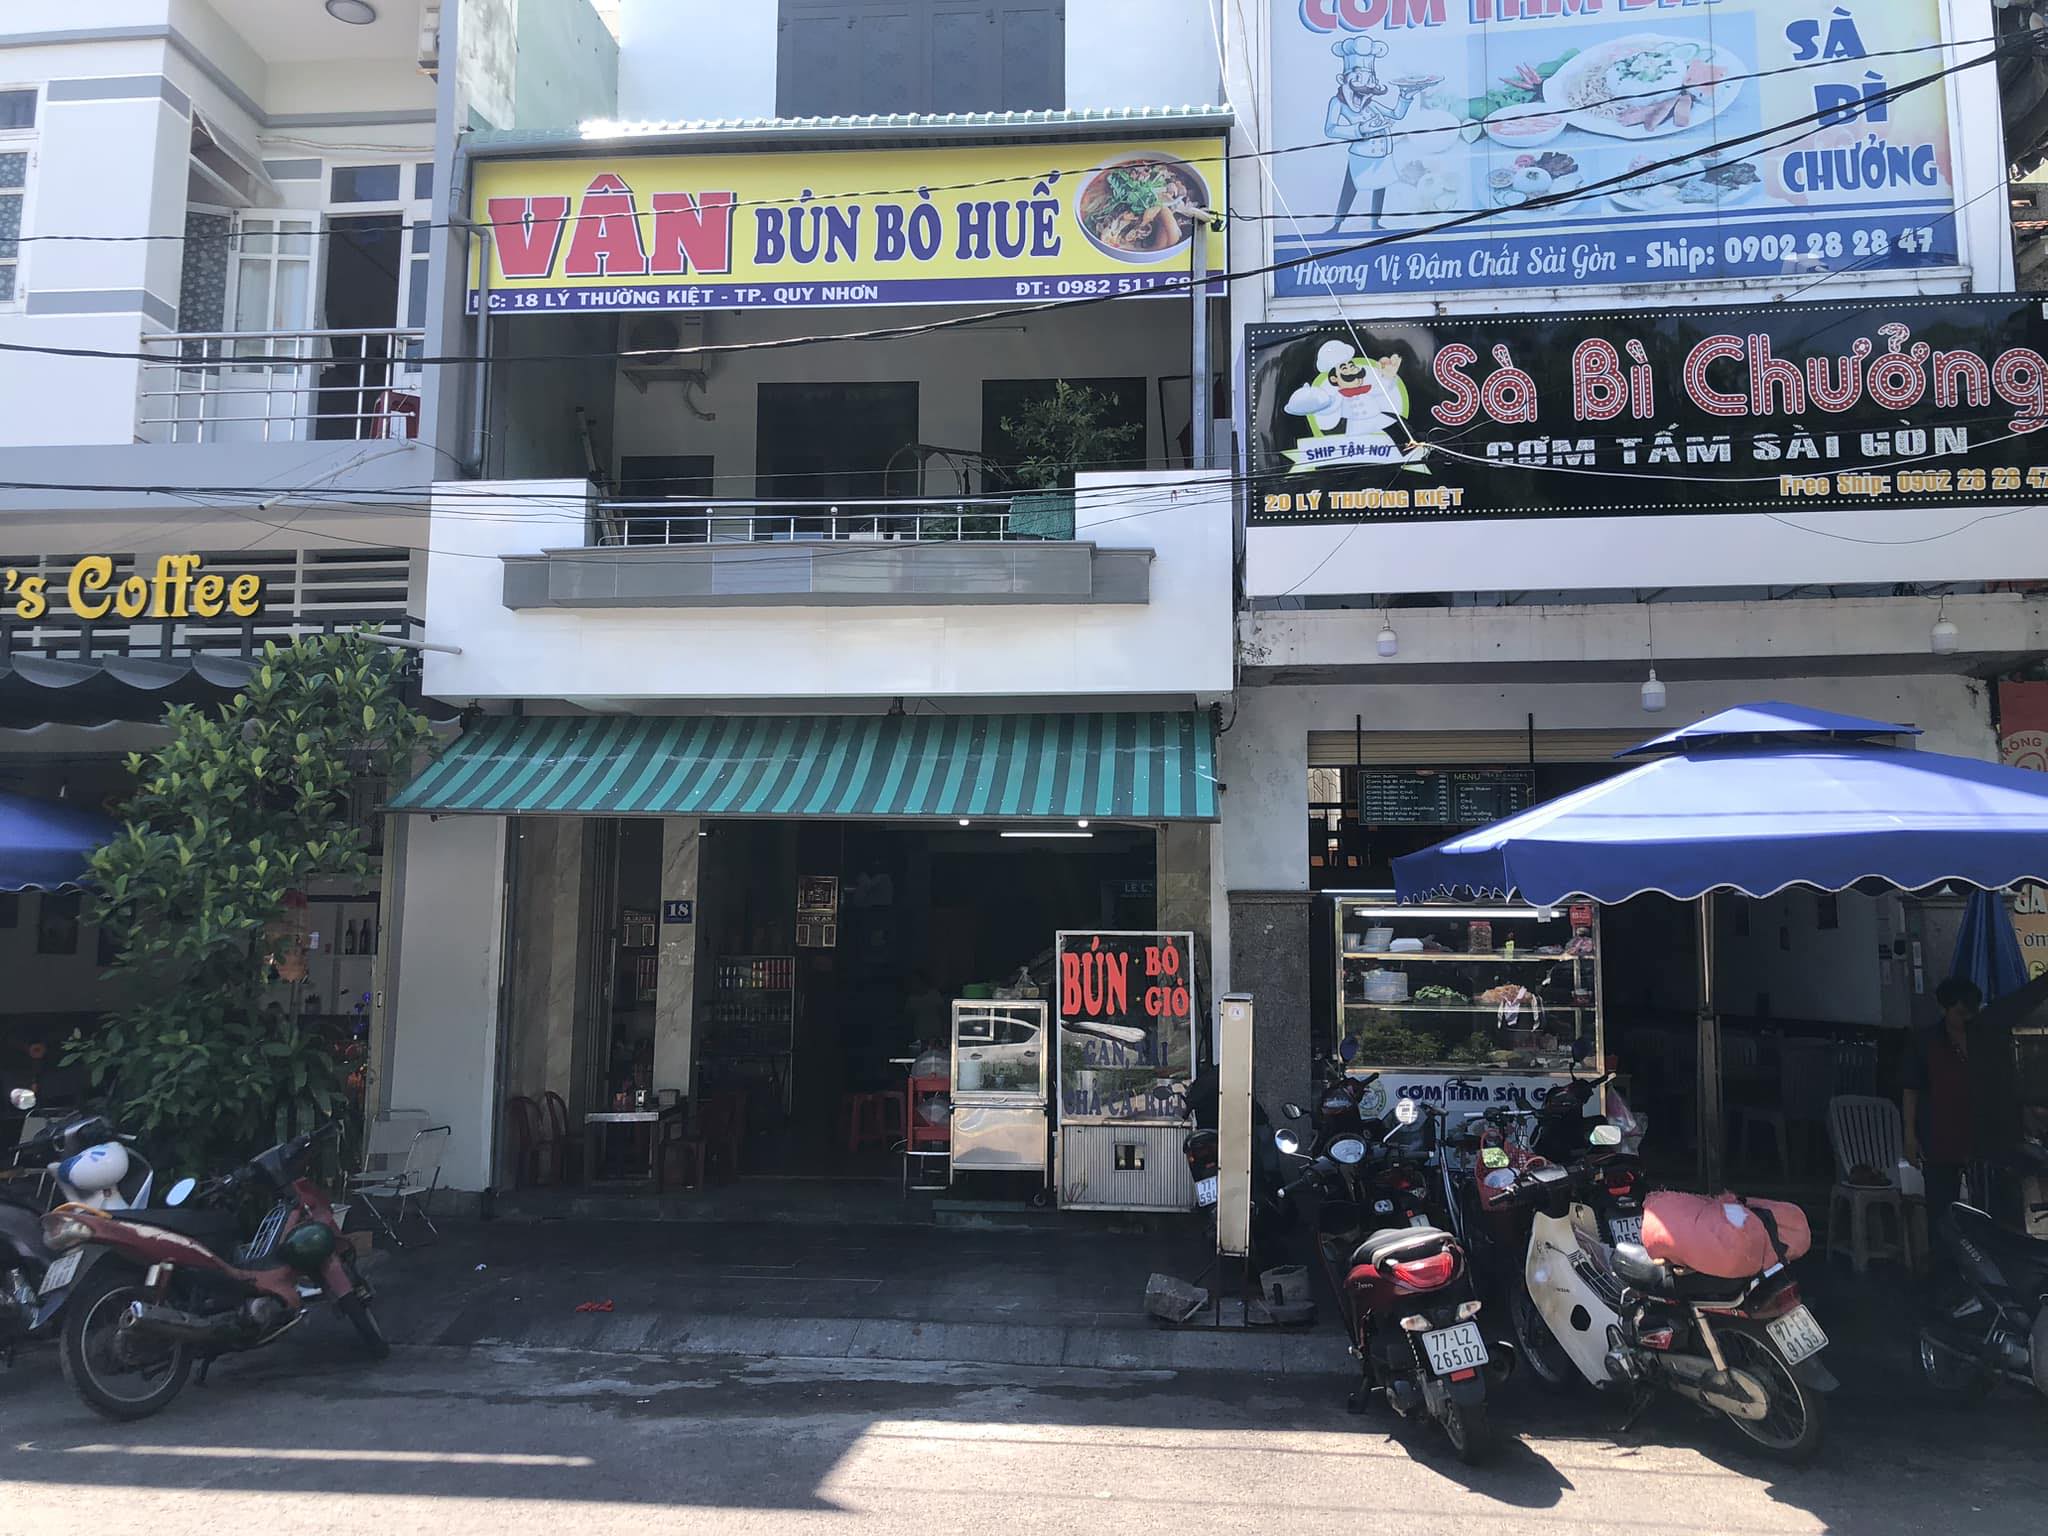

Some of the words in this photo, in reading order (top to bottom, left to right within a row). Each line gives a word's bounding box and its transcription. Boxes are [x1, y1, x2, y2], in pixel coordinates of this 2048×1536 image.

[1786, 6, 1867, 61] SÀ
[1814, 70, 1888, 125] BÌ
[1782, 133, 1938, 193] CHƯỞNG
[488, 173, 738, 280] VÂN
[753, 188, 861, 264] BÚN
[874, 186, 942, 262] BÒ
[955, 170, 1062, 260] HUẾ
[1374, 253, 1402, 286] Vị
[1406, 252, 1462, 285] Đậm
[1469, 243, 1521, 278] Chất
[1527, 245, 1567, 275] Sài
[1571, 244, 1617, 279] Gòn
[1646, 237, 1715, 273] Ship:
[1724, 232, 1798, 264] 0902
[1805, 230, 1844, 260] 28
[1851, 228, 1889, 257] 28
[1897, 226, 1934, 255] 47
[513, 293, 539, 308] 18
[544, 289, 571, 307] LÝ
[577, 287, 661, 305] THƯỜNG
[666, 286, 714, 306] KIỆT
[734, 288, 767, 303] TP.
[773, 287, 815, 304] QUY
[821, 284, 879, 301] NHƠN
[1015, 281, 1050, 296] ĐT:
[1057, 279, 1111, 295] 0982
[1117, 277, 1156, 293] 511
[1431, 343, 1538, 427] Sà
[1572, 338, 1654, 421] Bì
[1682, 322, 2048, 434] Chưởng
[1306, 446, 1336, 461] SHIP
[1339, 442, 1366, 458] TẬN
[1486, 435, 1596, 467] CƠM
[1615, 422, 1732, 465] TẤM
[1752, 423, 1841, 461] SÀI
[1859, 418, 1969, 457] GÒN
[1264, 493, 1292, 513] 20
[1296, 489, 1323, 511] LÝ
[1328, 486, 1410, 510] THƯỜNG
[1414, 485, 1464, 511] KIỆT
[1780, 474, 1831, 497] Free
[1837, 471, 1892, 497] Ship:
[1897, 469, 1953, 493] 0902
[1957, 467, 1986, 491] 28
[1991, 466, 2021, 490] 28
[66, 554, 263, 621] Coffee
[667, 903, 689, 917] 18
[1062, 935, 1129, 1016] BÚN
[1145, 936, 1180, 976] BÒ
[1395, 1083, 1443, 1101] CƠM
[1431, 1327, 1474, 1351] 77-L2
[1432, 1344, 1485, 1371] 265.02
